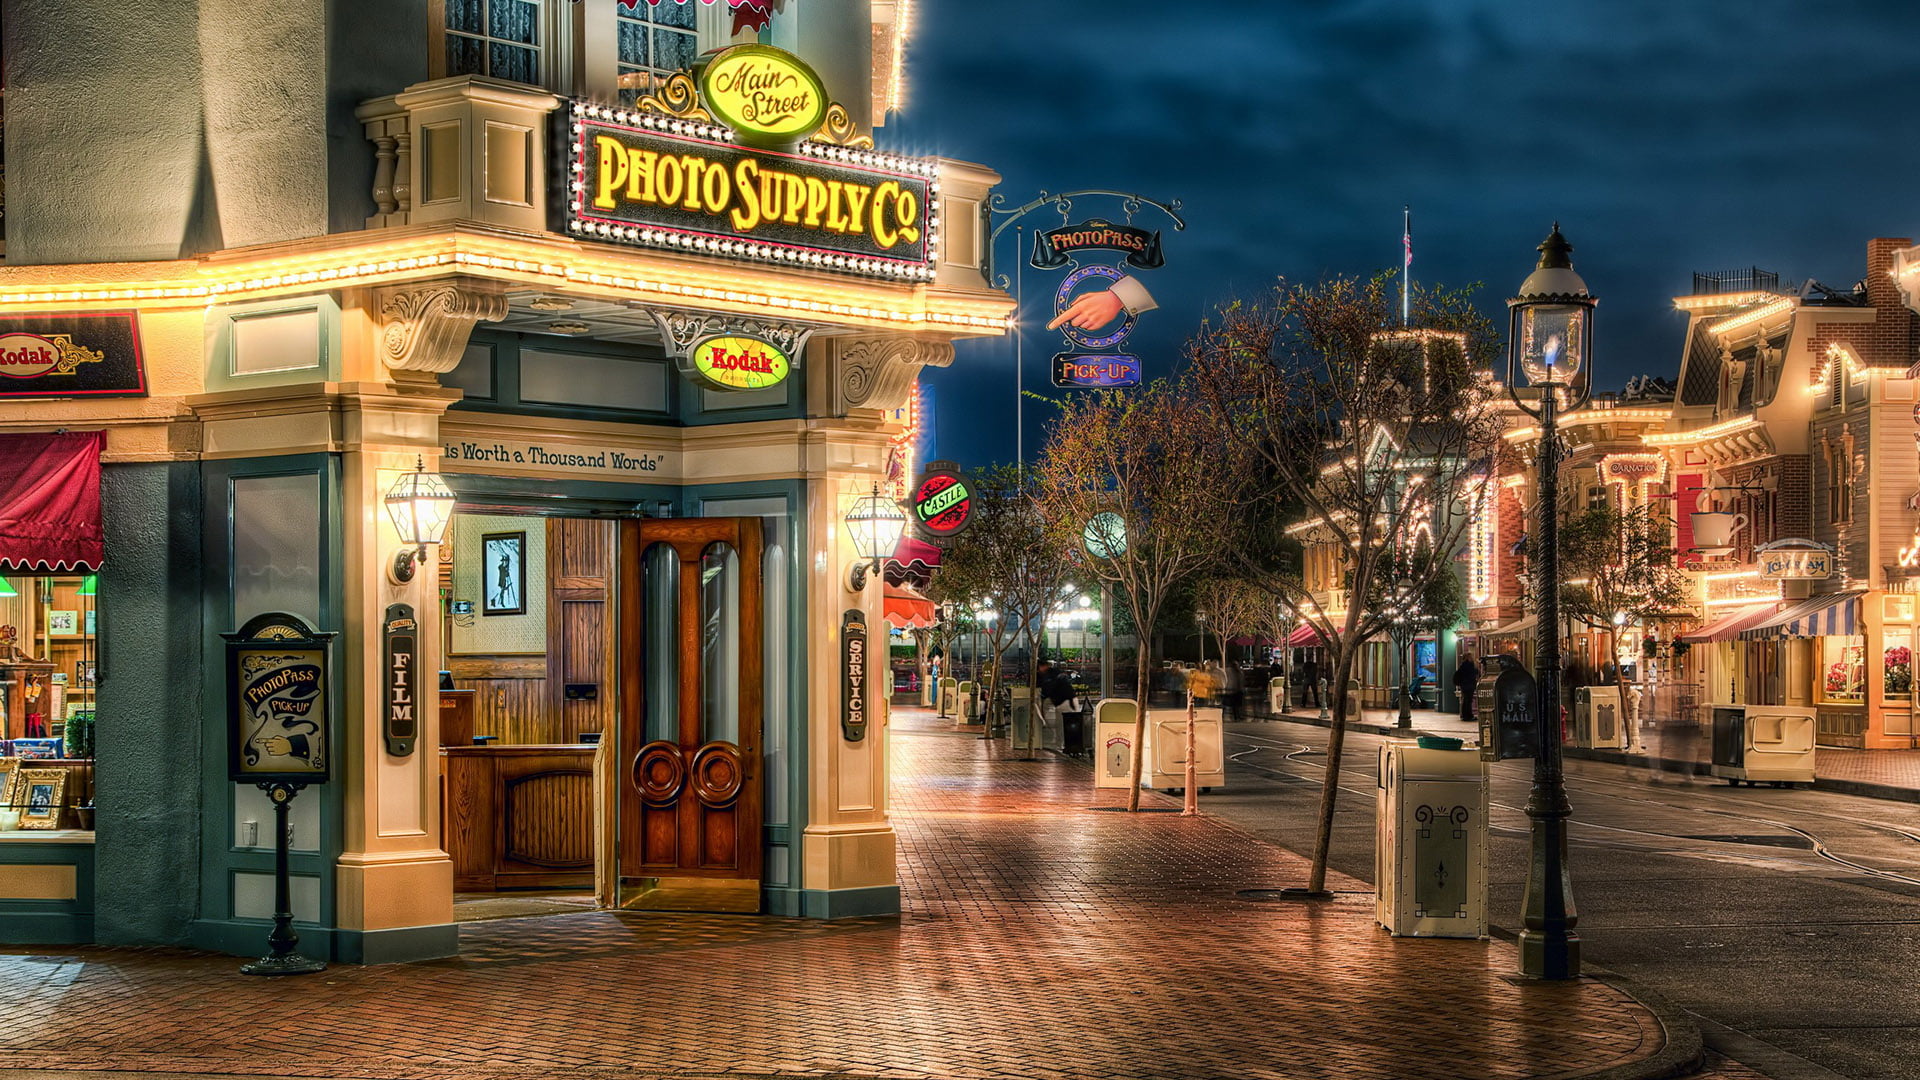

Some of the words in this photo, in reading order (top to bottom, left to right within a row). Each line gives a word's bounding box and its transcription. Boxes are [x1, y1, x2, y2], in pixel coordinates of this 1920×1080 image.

[716, 62, 798, 96] Main
[742, 91, 811, 127] Street
[594, 136, 730, 212] PHOTO
[732, 159, 871, 231] SUPPLY
[711, 347, 773, 374] Kodak
[1062, 363, 1131, 379] PICK-UP
[444, 443, 459, 459] is
[461, 442, 510, 462] Worth
[513, 450, 525, 463] a
[527, 446, 605, 468] Thousand
[610, 452, 664, 471] Words"
[1609, 461, 1658, 475] CARNATION
[921, 484, 962, 521] CASTLE
[1785, 560, 1826, 573] CRAM
[392, 653, 413, 720] FILM
[849, 640, 862, 722] SERVICE
[271, 700, 310, 712] PICK-UP
[1502, 712, 1532, 722] MAIL
